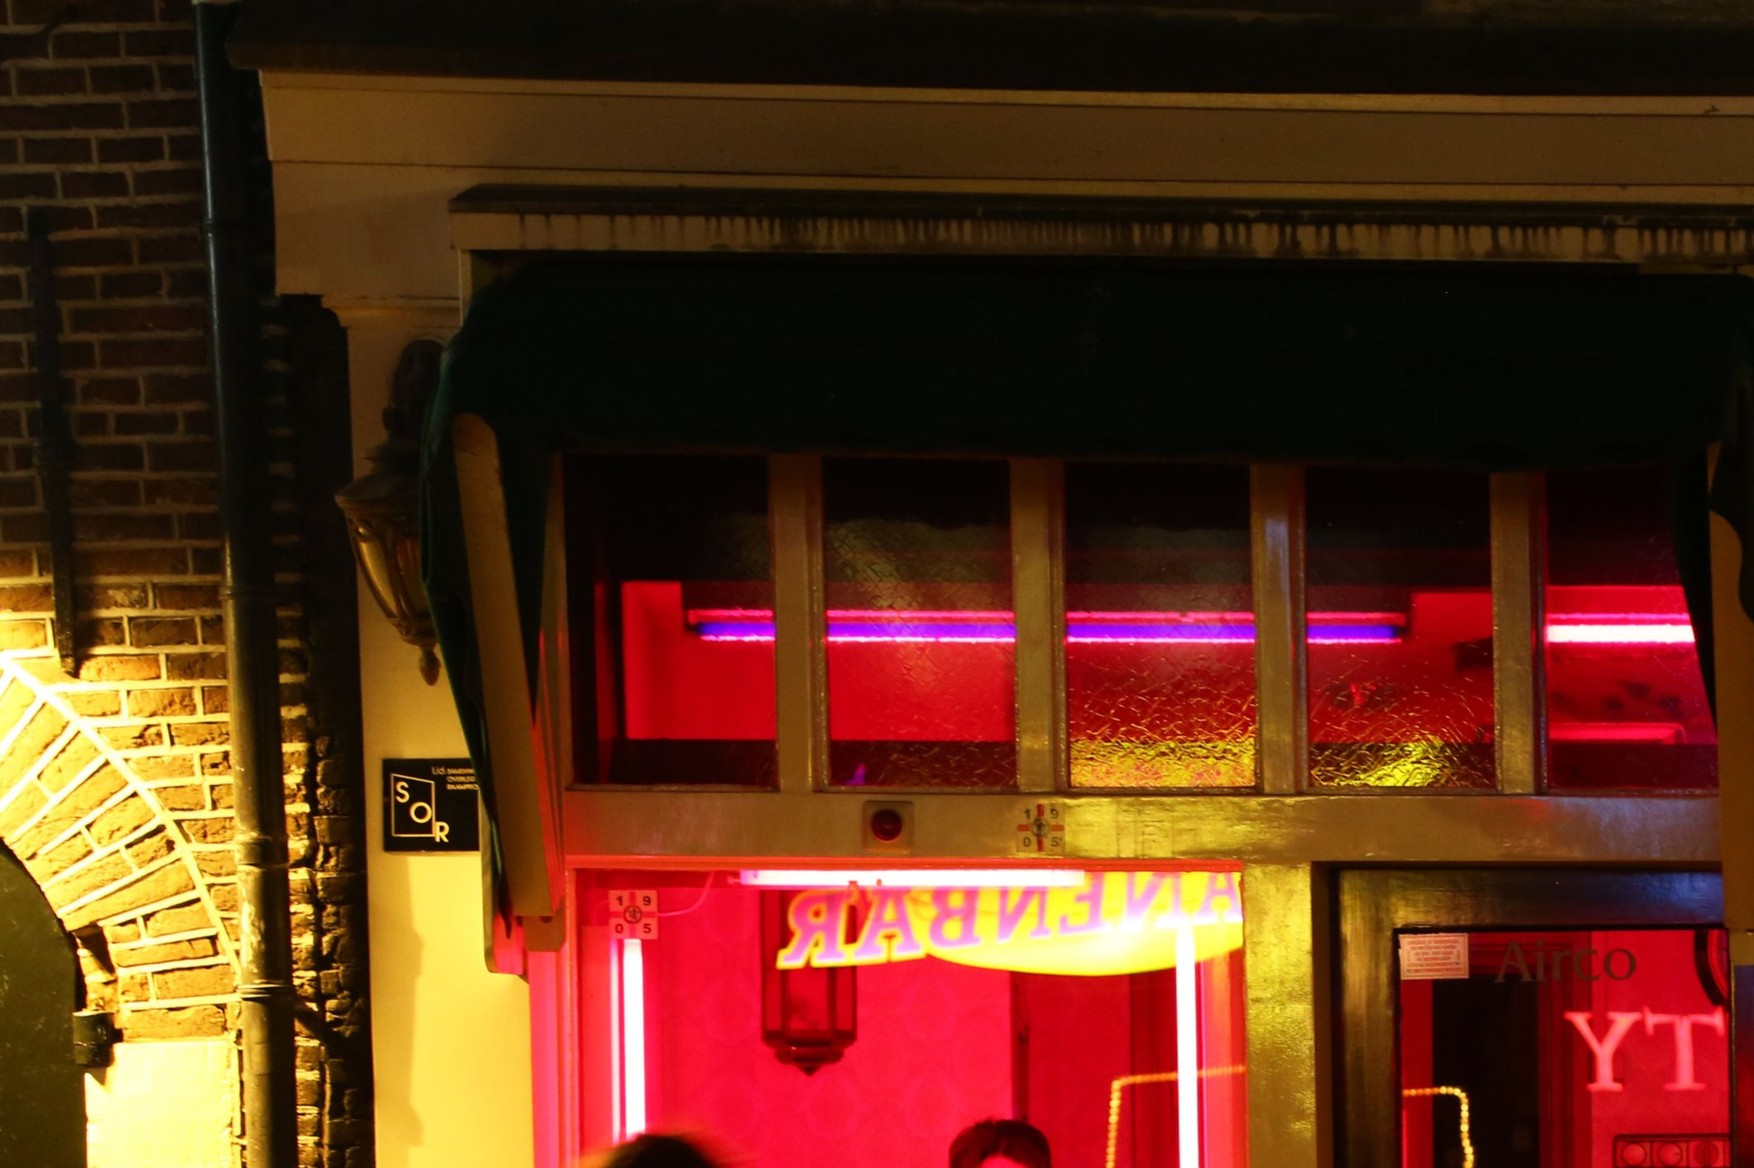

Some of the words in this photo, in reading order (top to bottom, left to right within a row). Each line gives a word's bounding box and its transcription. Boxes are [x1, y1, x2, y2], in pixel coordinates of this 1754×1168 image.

[395, 781, 450, 843] SOR
[615, 895, 624, 906] 1
[642, 895, 652, 906] 9
[642, 923, 652, 934] 5
[1494, 941, 1637, 983] Airco
